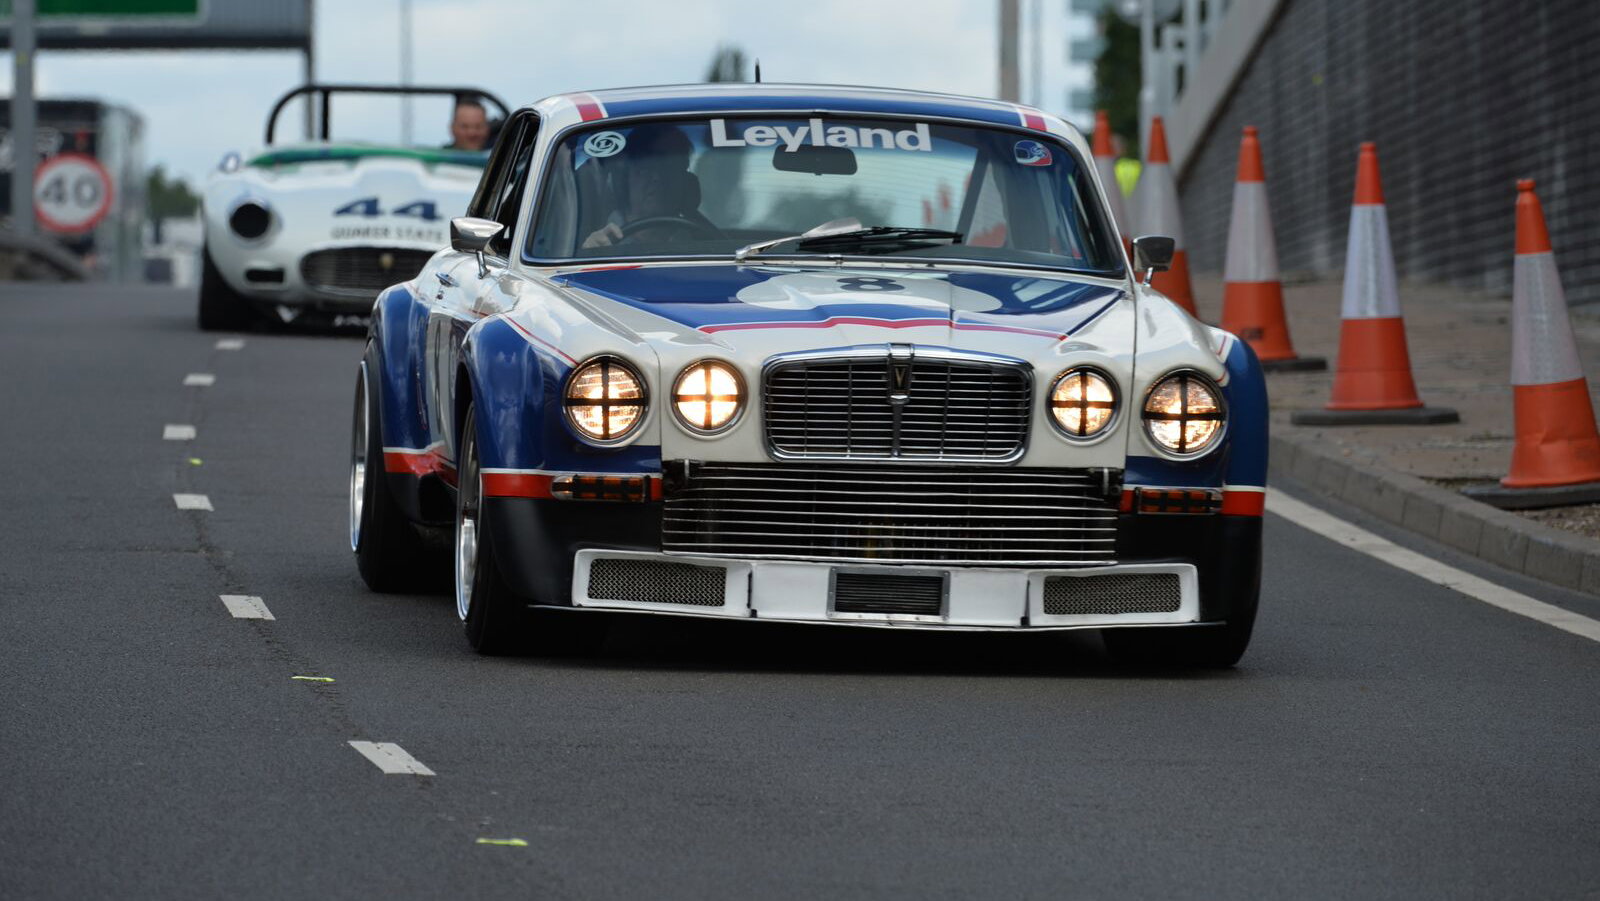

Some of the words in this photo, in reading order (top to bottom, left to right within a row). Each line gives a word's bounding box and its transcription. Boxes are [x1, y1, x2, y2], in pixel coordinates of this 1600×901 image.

[710, 119, 932, 152] Leyland
[42, 173, 100, 209] 40
[333, 197, 442, 221] 44
[331, 226, 389, 240] QUAKER
[396, 227, 443, 242] STATE
[836, 277, 905, 292] 8
